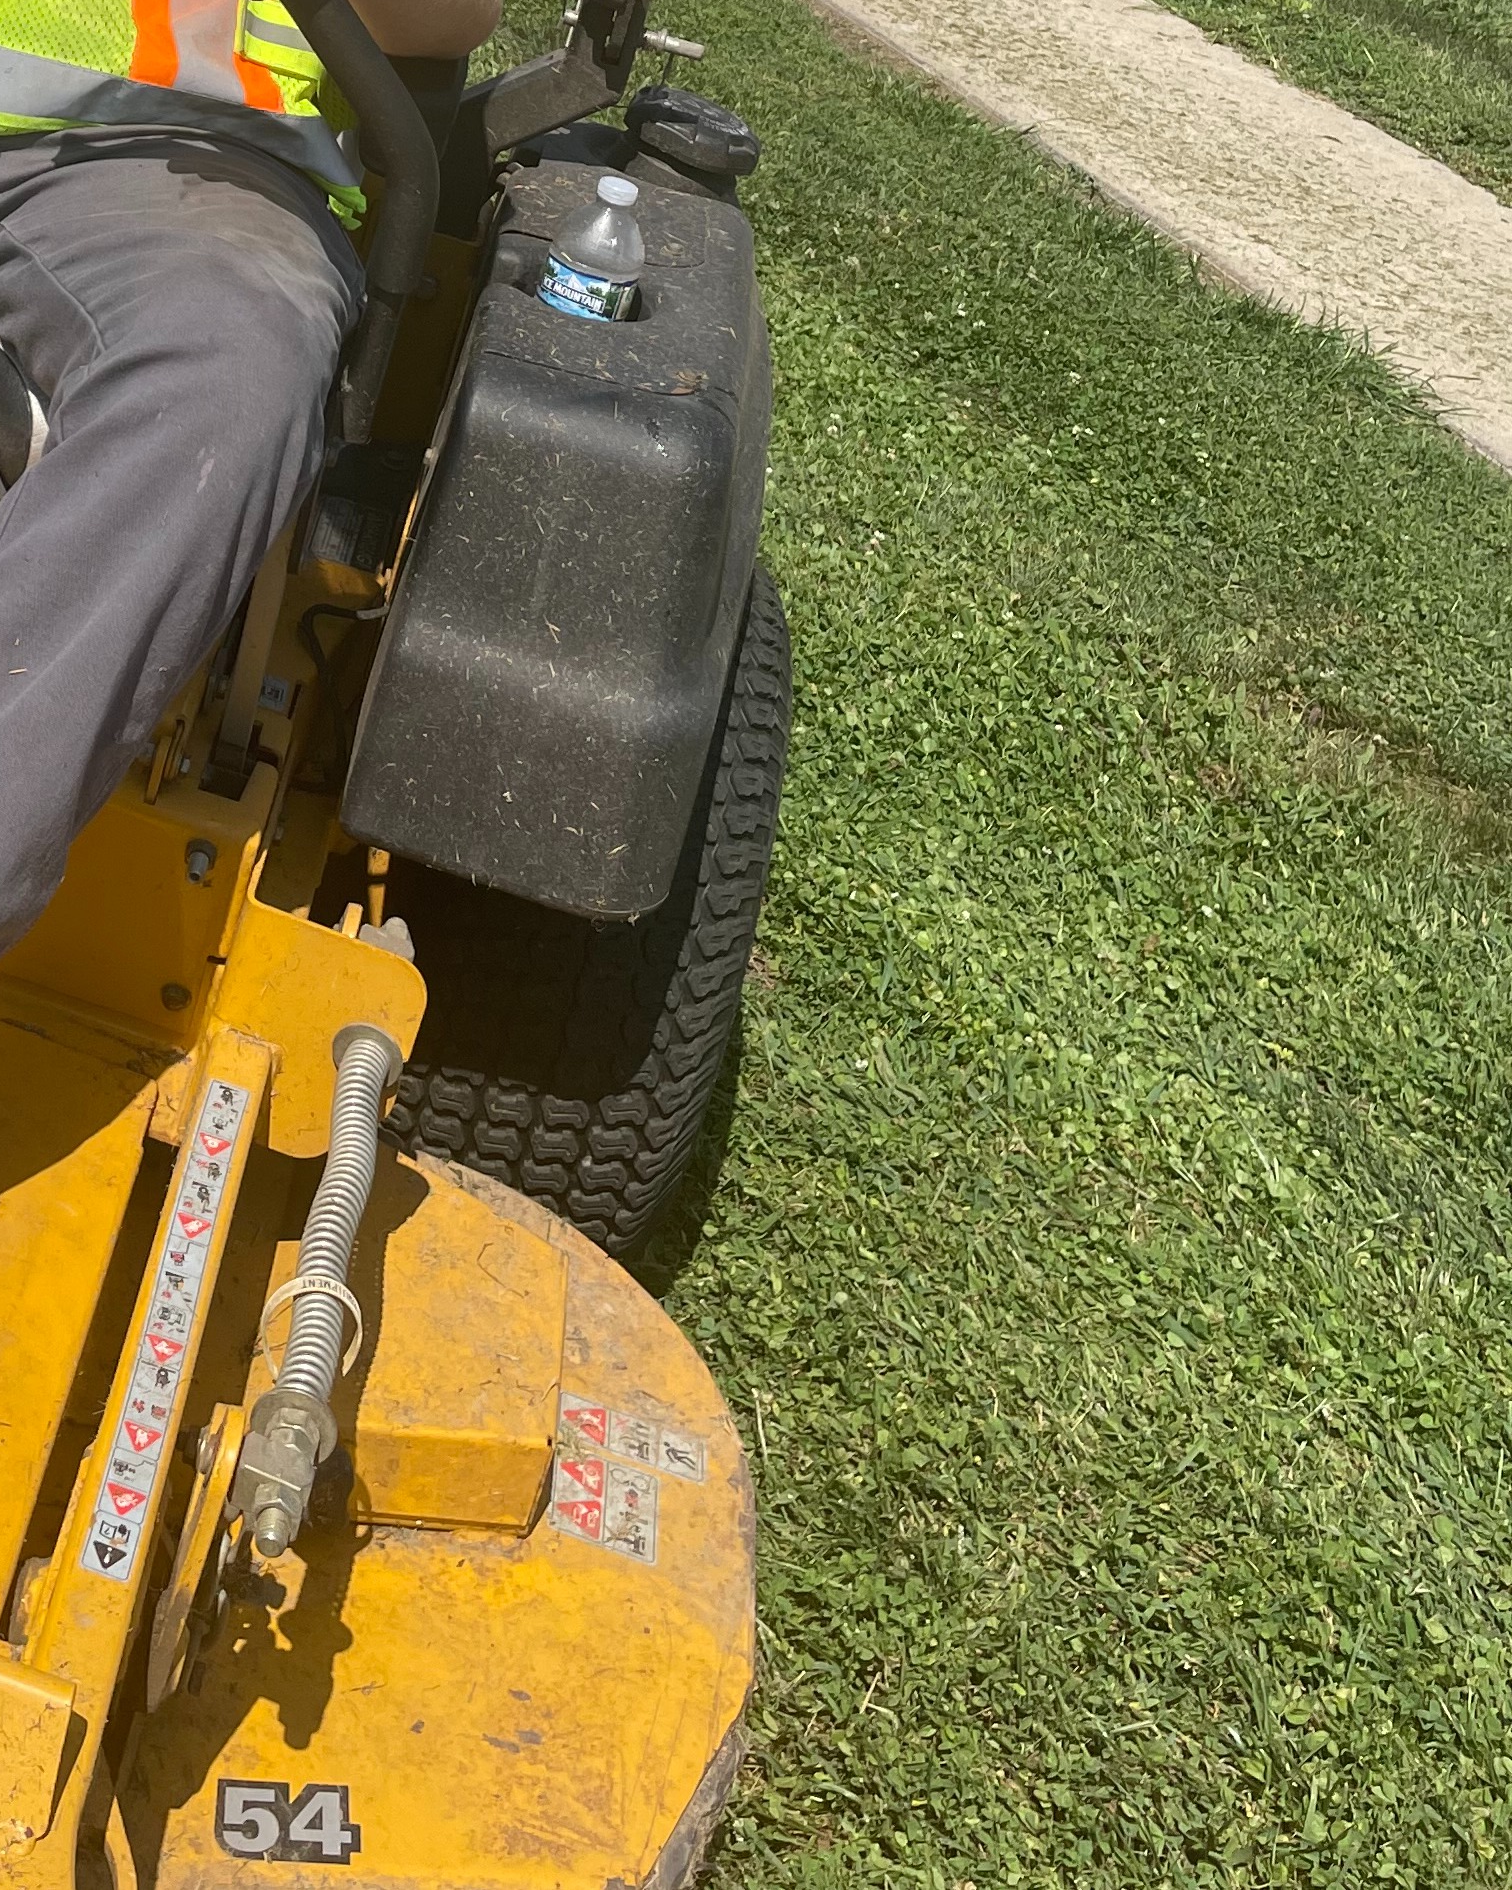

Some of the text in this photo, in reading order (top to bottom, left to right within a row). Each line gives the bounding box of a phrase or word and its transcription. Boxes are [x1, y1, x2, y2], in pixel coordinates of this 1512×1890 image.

[543, 276, 604, 312] ICE MOUNTAIN
[222, 1785, 353, 1856] 54
